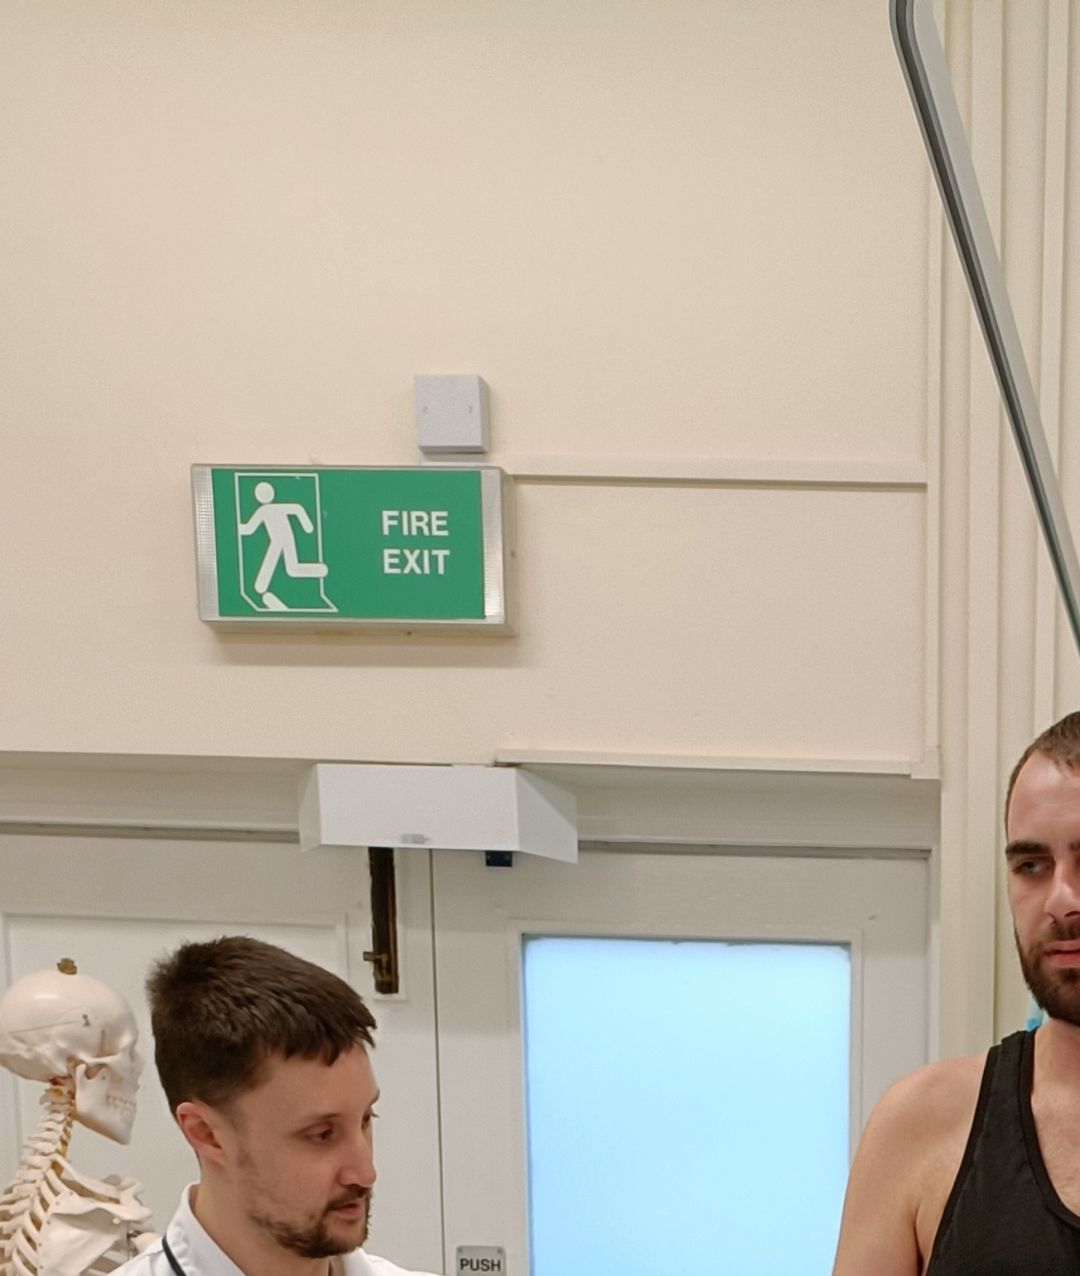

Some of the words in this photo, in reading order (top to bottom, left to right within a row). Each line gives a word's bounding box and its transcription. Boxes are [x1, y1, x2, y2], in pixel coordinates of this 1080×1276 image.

[381, 510, 449, 536] FIRE
[382, 549, 450, 575] EXIT
[460, 1258, 502, 1272] PUSH
